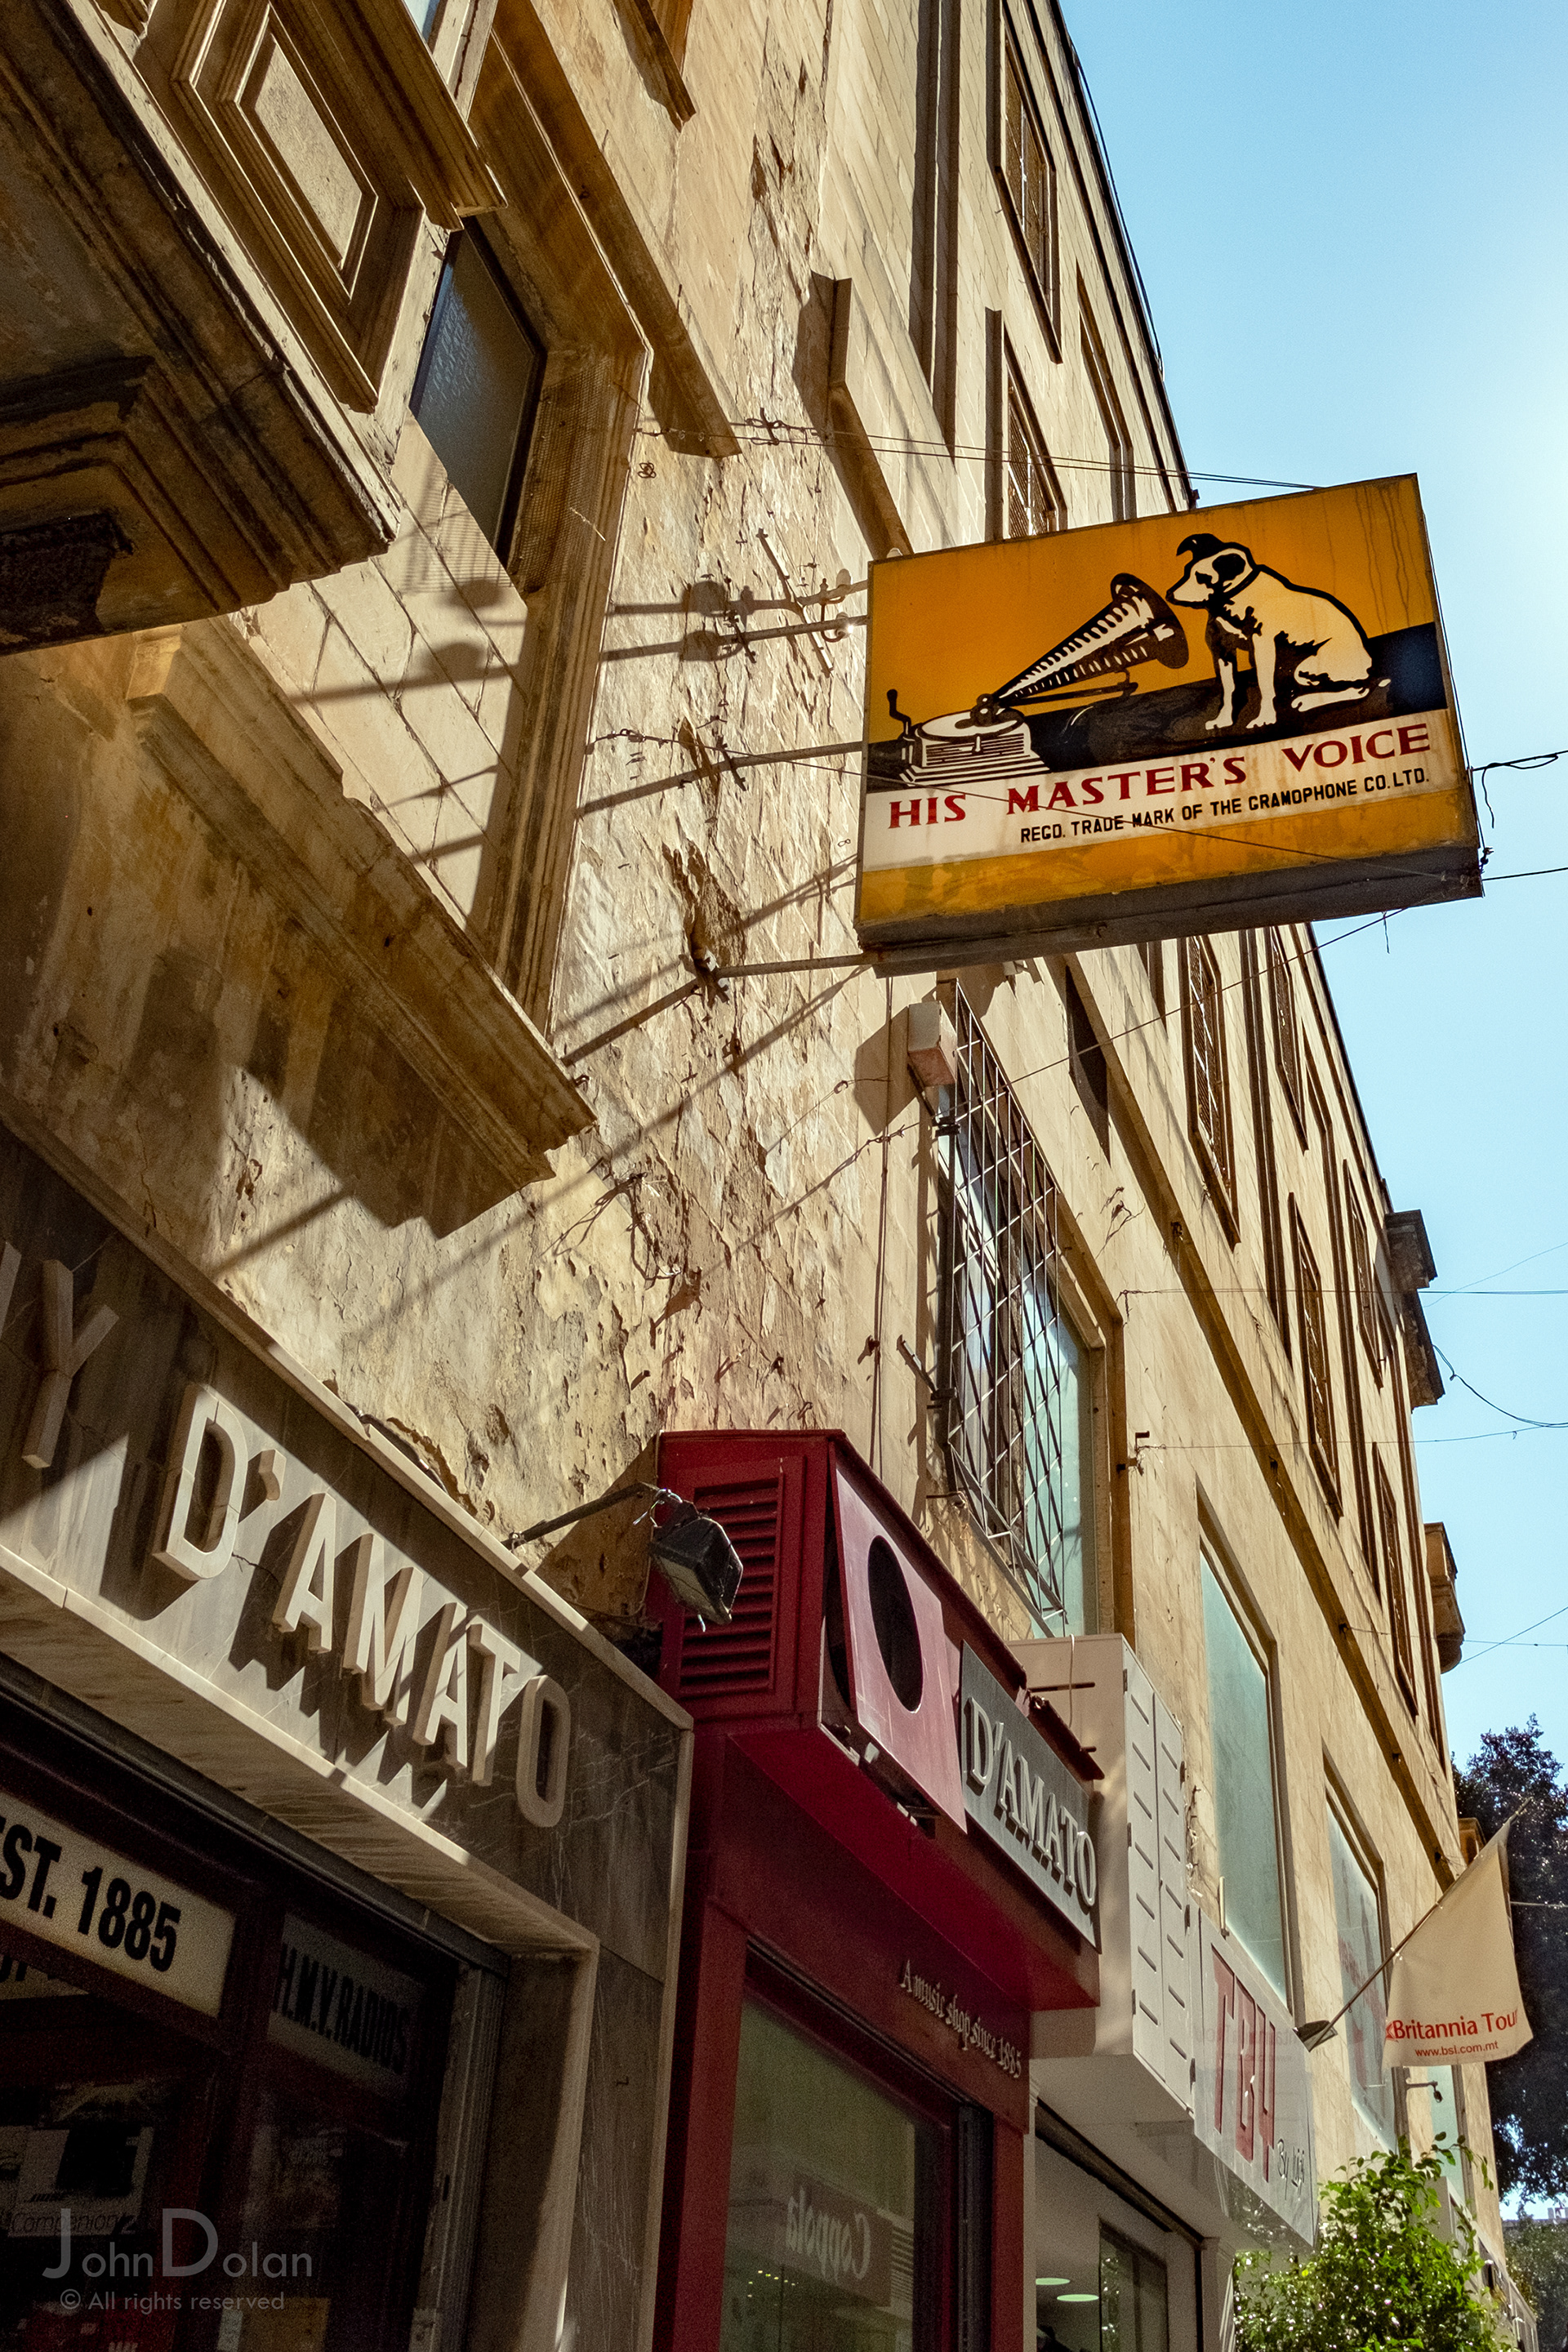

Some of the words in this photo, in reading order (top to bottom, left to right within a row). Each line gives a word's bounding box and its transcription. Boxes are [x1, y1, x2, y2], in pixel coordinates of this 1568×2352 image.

[889, 793, 967, 829] HIS
[1006, 756, 1246, 815] MASTER'S
[1282, 724, 1430, 773] VOICE
[1020, 823, 1066, 843] REGD.
[1071, 815, 1124, 836] TRADE
[1132, 808, 1174, 827] MARK
[1182, 804, 1203, 821] OF
[1210, 798, 1242, 816] THE
[1249, 779, 1357, 811] GRAMOPHONE
[153, 1381, 571, 1829] D'AMATO
[963, 1695, 1097, 1909] D'AMATO
[0, 1815, 62, 1919] ST.
[78, 1866, 181, 1972] 1885
[899, 1958, 913, 1993] A
[912, 1974, 946, 2019] music
[945, 1993, 972, 2051] shop
[969, 2016, 997, 2060] since
[996, 2036, 1022, 2079] 1885
[1393, 2016, 1478, 2040] Britannia
[1414, 2040, 1499, 2057] www.bsl.com.mt
